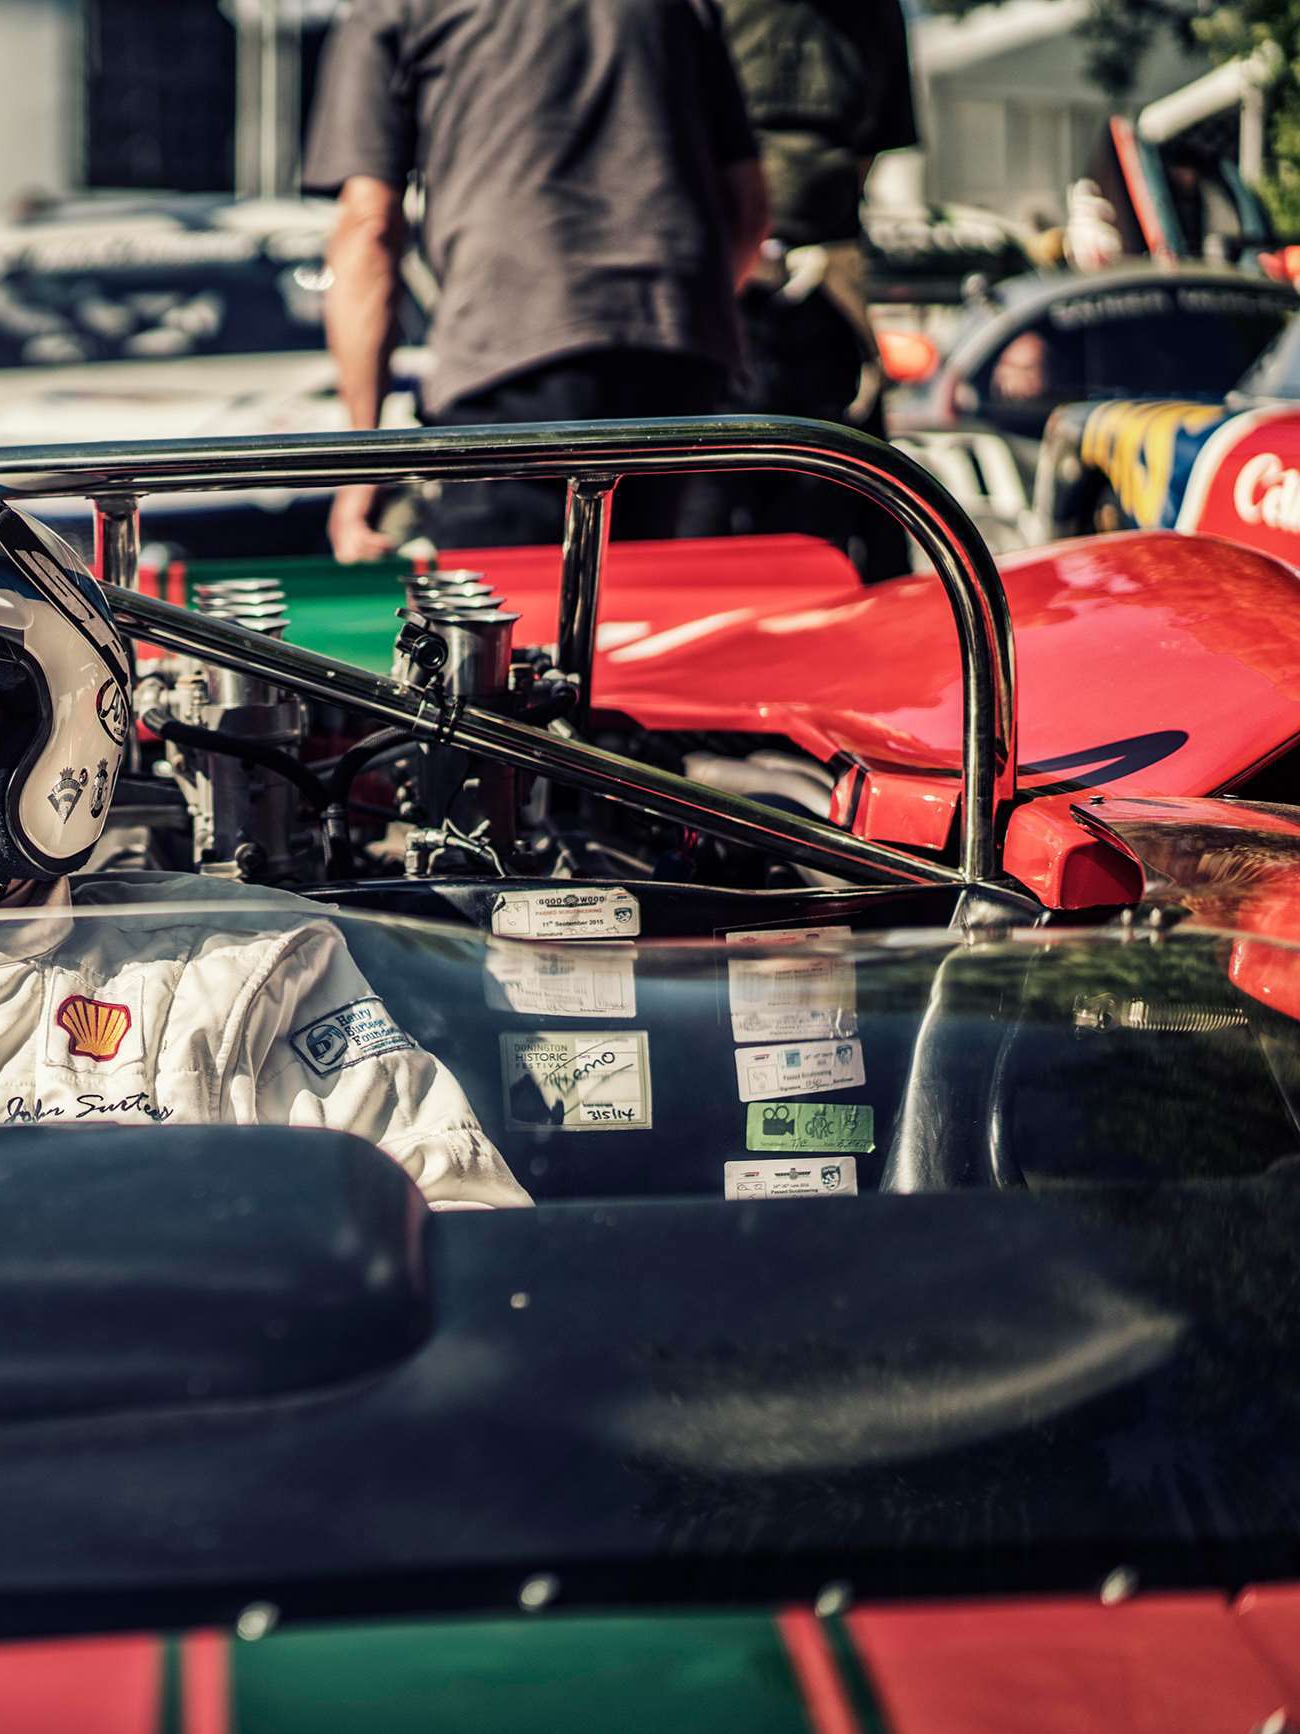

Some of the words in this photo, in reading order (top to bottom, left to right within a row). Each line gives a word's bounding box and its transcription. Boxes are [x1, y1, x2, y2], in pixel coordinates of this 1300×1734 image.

[539, 897, 562, 905] GOOD
[580, 895, 605, 903] WOOD
[336, 1009, 372, 1026] Henry
[514, 1043, 568, 1052] DONINGTON
[515, 1052, 568, 1062] HISTORIC
[515, 1062, 568, 1070] FESTIVAL
[4, 1096, 65, 1124] John
[804, 1116, 835, 1140] GRRC
